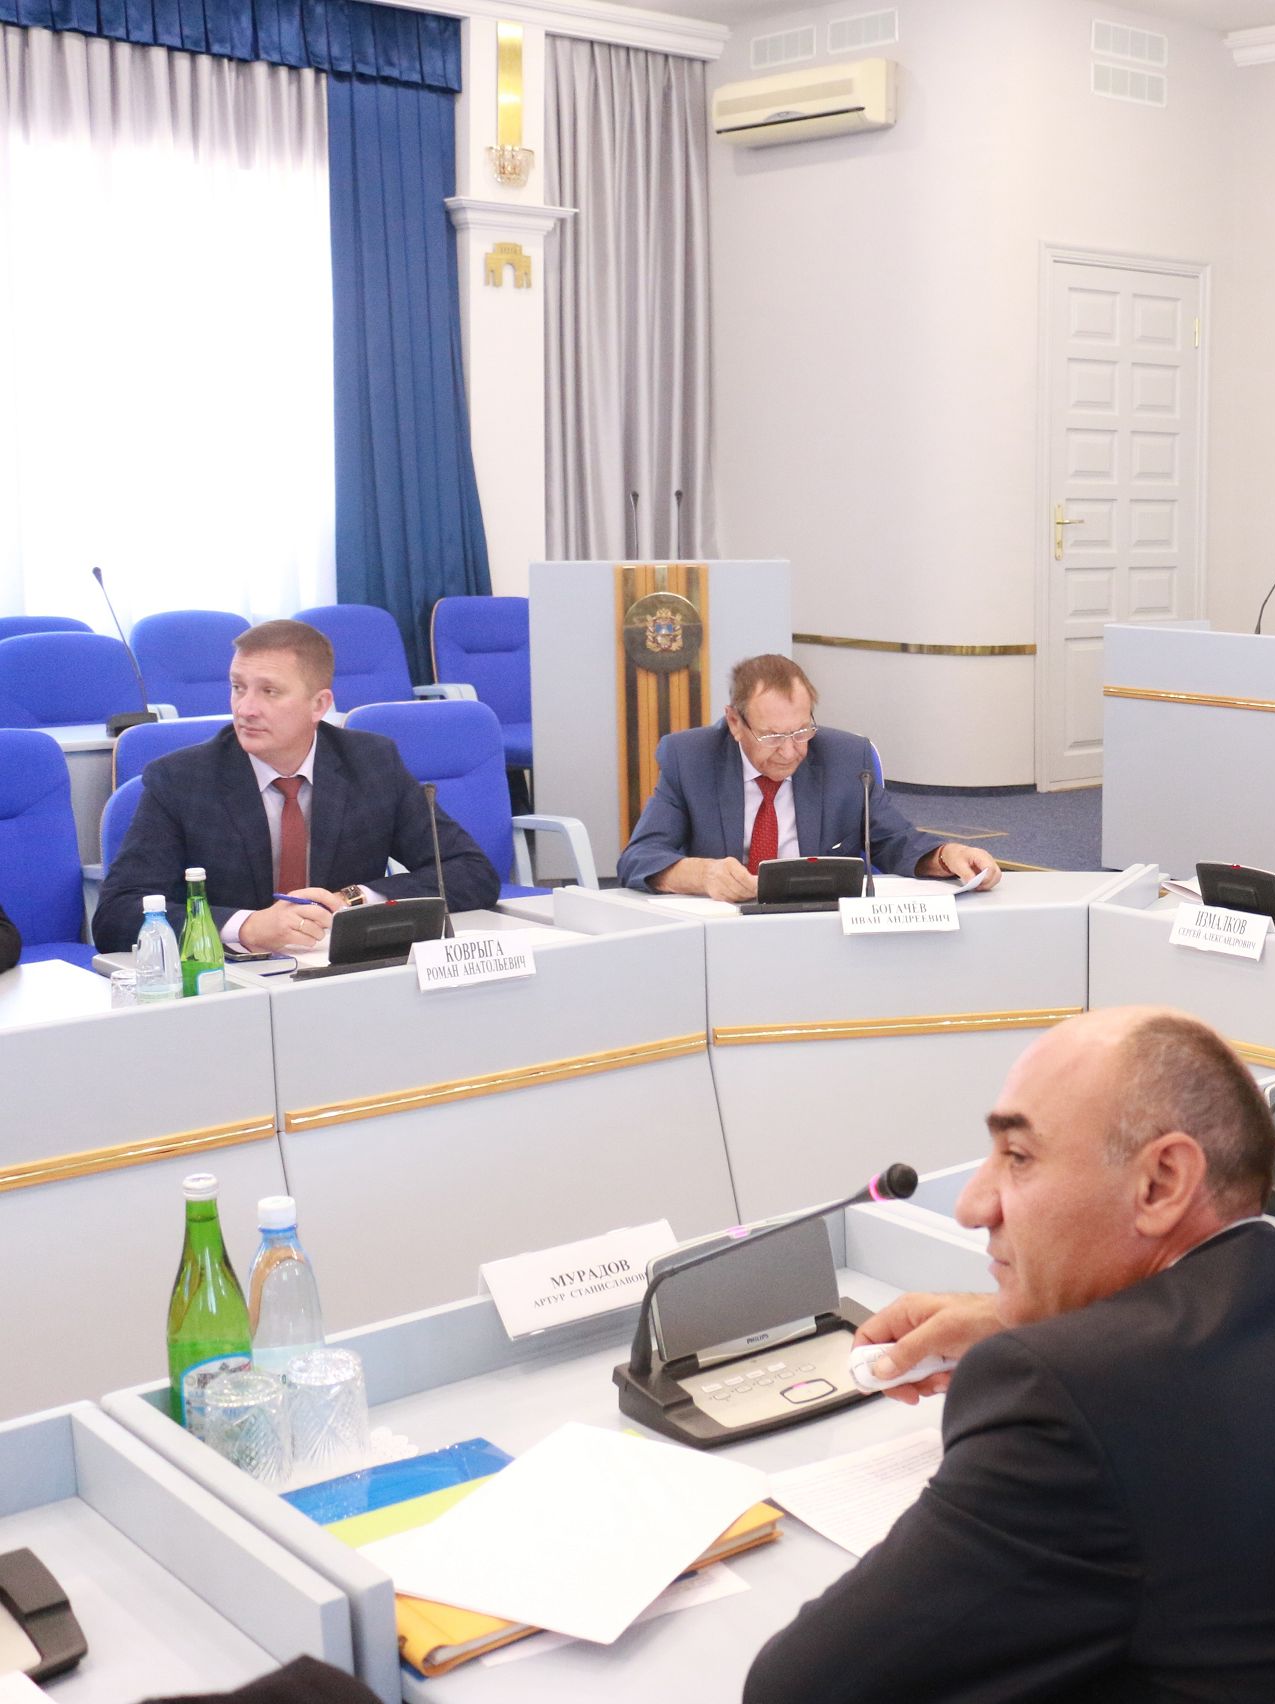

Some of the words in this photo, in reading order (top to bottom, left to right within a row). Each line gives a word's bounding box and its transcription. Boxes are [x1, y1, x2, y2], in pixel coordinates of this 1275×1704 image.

[851, 916, 881, 925] ИВАН
[887, 914, 950, 924] АНДРЕЕВИЧ
[1195, 911, 1248, 935] ИЗМАЛКОВ
[444, 940, 504, 962] КОВРЫГА
[426, 964, 460, 981] РОМАН
[463, 955, 526, 976] АНАТОЛЬЕВИЧ
[550, 1259, 631, 1289] МУРАДОВ
[533, 1293, 565, 1309] АРТУР
[570, 1272, 648, 1298] СТАНИСЛАВОВ
